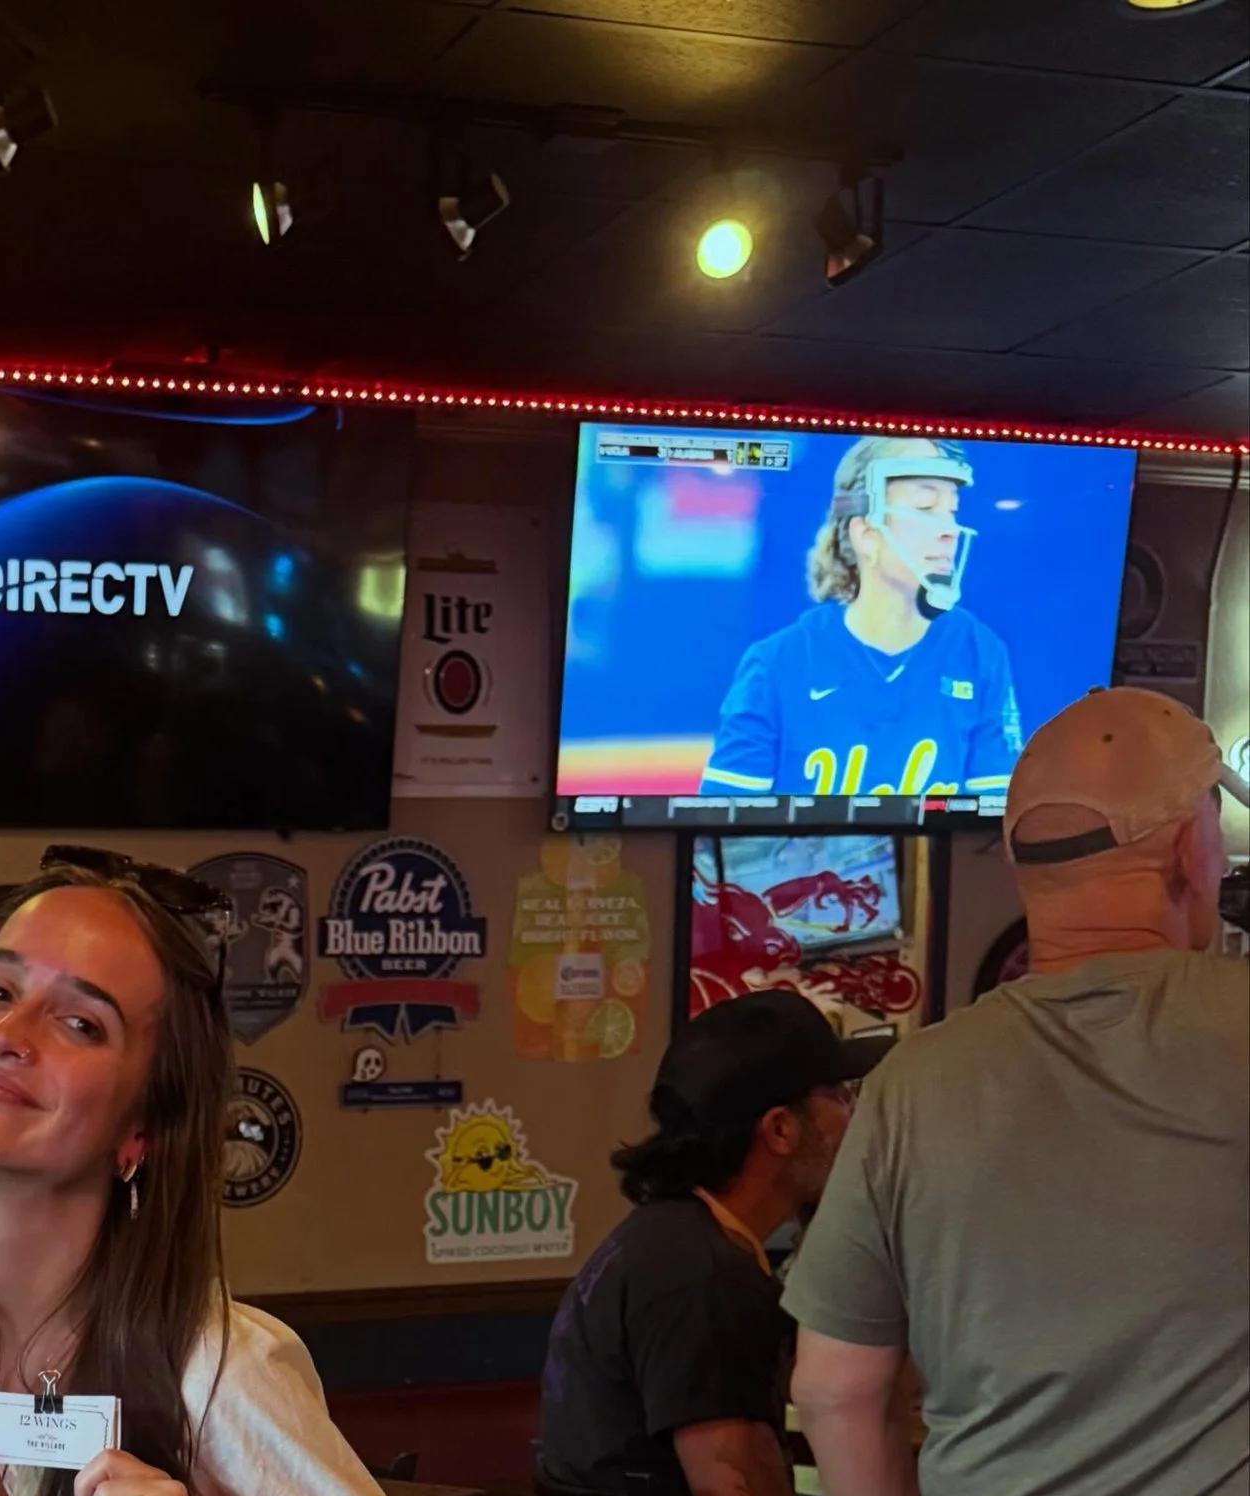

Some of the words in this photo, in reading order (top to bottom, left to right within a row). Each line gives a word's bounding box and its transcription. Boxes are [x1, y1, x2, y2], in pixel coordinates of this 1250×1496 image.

[422, 593, 493, 644] Lite
[359, 862, 447, 914] Pabst
[324, 919, 384, 956] Blue
[387, 919, 482, 956] Ribbon
[381, 958, 427, 971] BEER
[428, 1184, 572, 1237] SUNBOY
[20, 1414, 30, 1426] 12
[34, 1416, 77, 1430] WINGS
[27, 1440, 38, 1448] THE
[41, 1441, 65, 1450] VILLAGE
